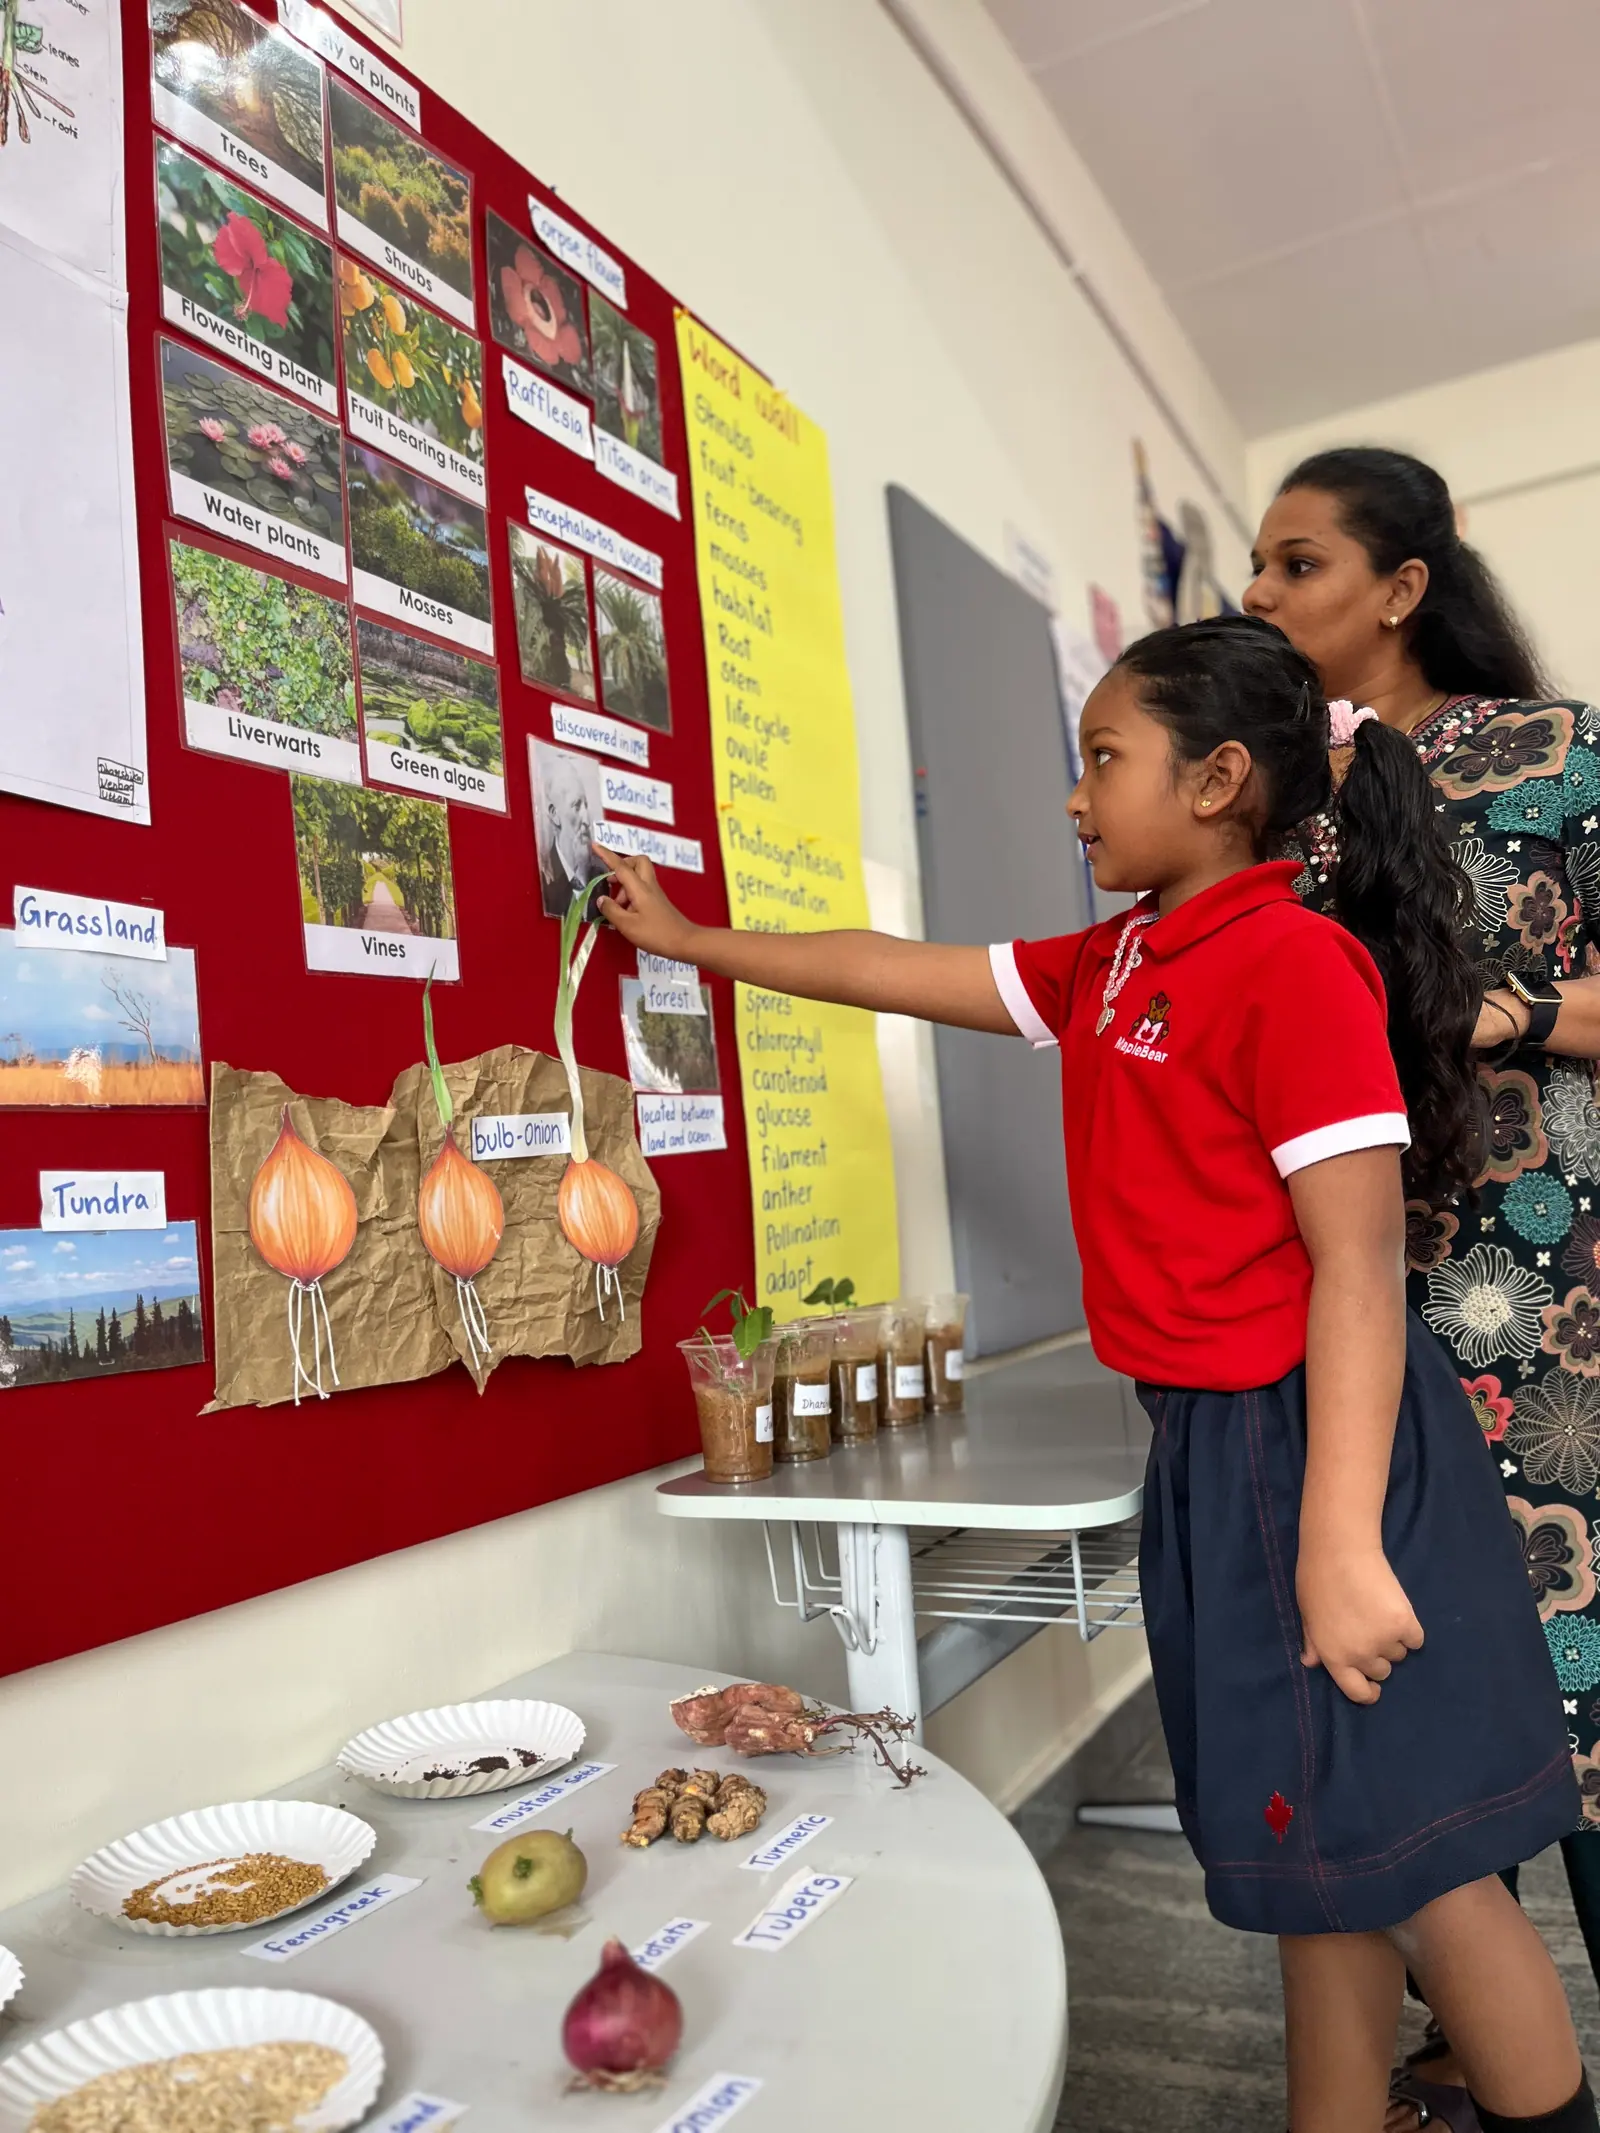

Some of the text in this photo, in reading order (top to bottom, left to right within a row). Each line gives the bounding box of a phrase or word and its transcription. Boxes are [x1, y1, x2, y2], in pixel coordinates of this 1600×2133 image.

[349, 54, 365, 75] of
[369, 69, 417, 118] plants
[220, 132, 268, 180] Trees
[384, 245, 433, 293] Shrubs
[181, 300, 323, 397] Flowering plant
[688, 328, 742, 401] Word
[508, 369, 584, 437] Rafflesia
[351, 397, 485, 488] Fruit bearing trees
[597, 436, 635, 480] Titan
[203, 491, 321, 561] Water plants
[399, 588, 454, 625] Mosses
[227, 716, 321, 759] Liverwarts
[555, 712, 617, 749] discovered
[390, 750, 487, 793] Green algae
[596, 821, 625, 847] John
[20, 895, 157, 946] Grassland
[360, 935, 407, 959] Vines
[649, 983, 690, 1011] forest
[1114, 1036, 1169, 1064] MapleBear
[641, 1097, 716, 1125] located between
[756, 1099, 813, 1139] glucose
[646, 1130, 666, 1153] land
[669, 1127, 685, 1148] and
[52, 1181, 149, 1218] Tundra
[762, 1177, 814, 1212] anther
[765, 1255, 815, 1303] adapt
[489, 1785, 565, 1829] mustard
[749, 1813, 827, 1871] Turmeric
[744, 1876, 841, 1945] Tubers
